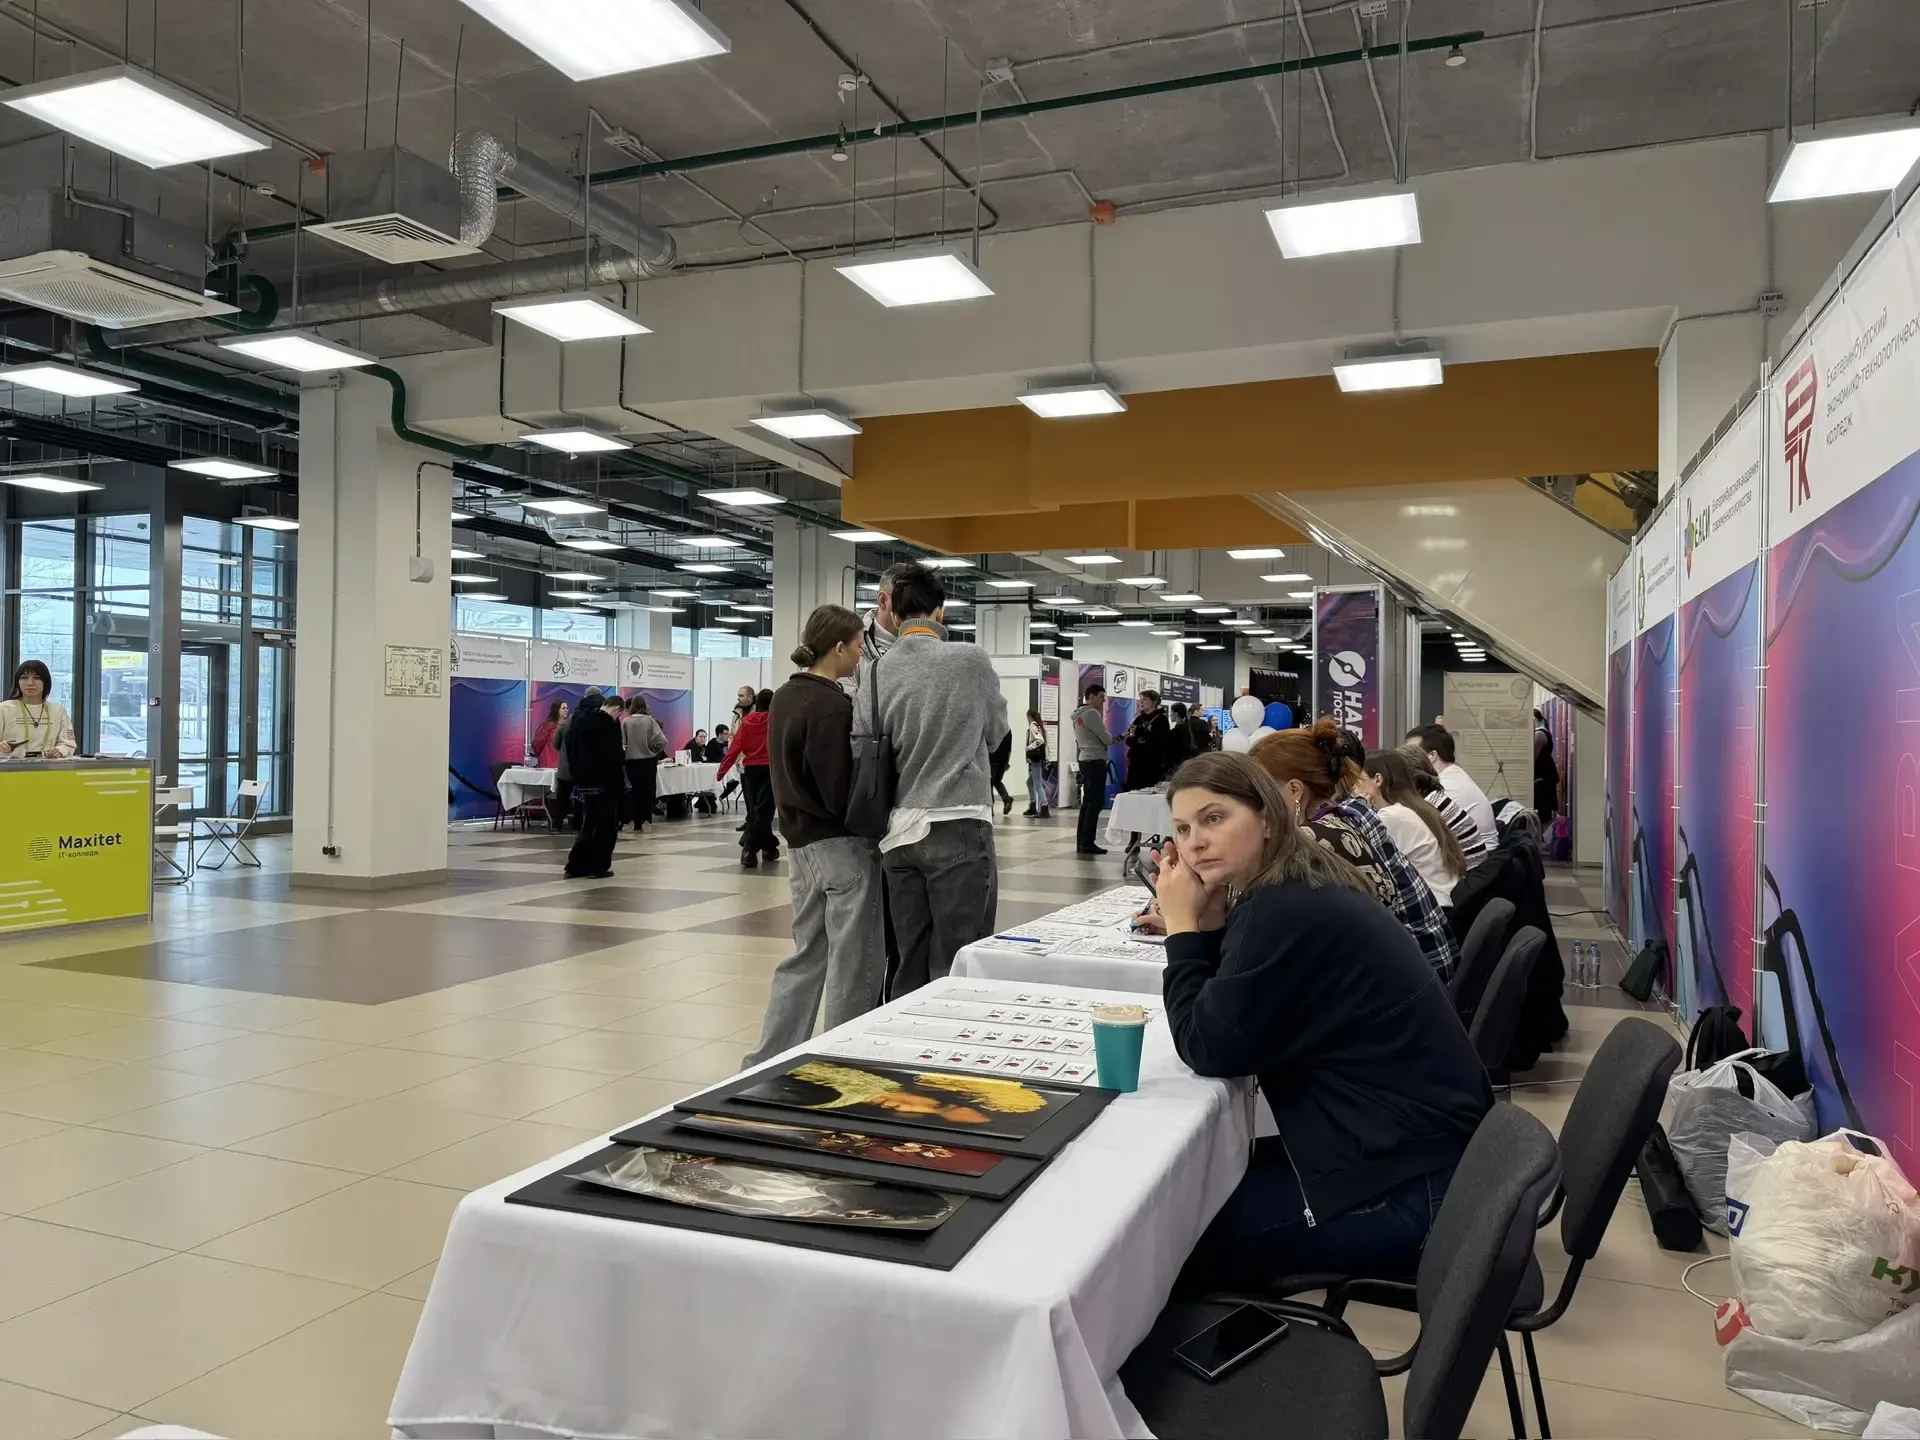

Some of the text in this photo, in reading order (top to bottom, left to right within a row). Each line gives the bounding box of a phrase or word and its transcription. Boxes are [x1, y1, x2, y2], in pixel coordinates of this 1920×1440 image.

[1826, 305, 1888, 388] Екатеринбургский
[1826, 412, 1853, 447] колледж
[59, 832, 122, 849] Maxitet
[59, 850, 99, 860] IT-колледж
